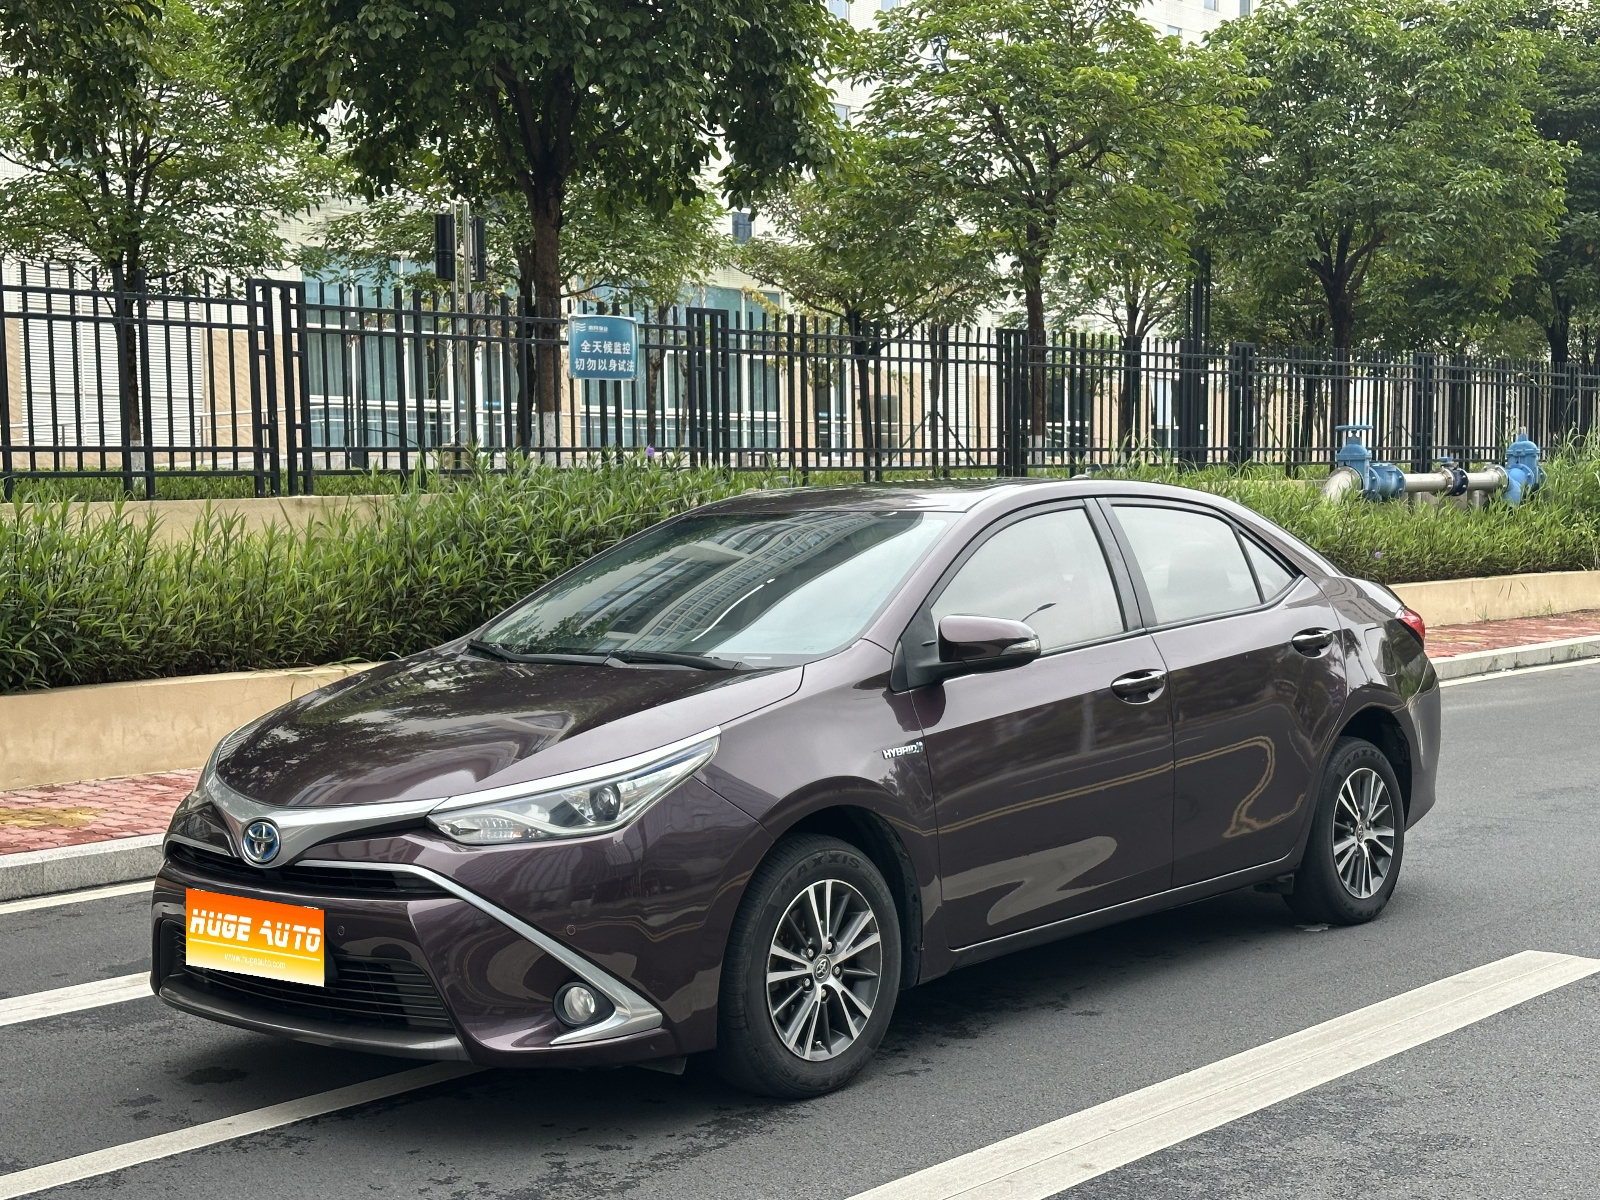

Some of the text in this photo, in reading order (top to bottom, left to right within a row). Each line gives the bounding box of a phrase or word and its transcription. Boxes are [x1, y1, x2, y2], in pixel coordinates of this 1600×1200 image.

[580, 340, 631, 355] 全天候监控
[574, 358, 635, 372] 切勿以身试法
[882, 744, 918, 759] HYBRID
[780, 853, 861, 896] MAXXIS
